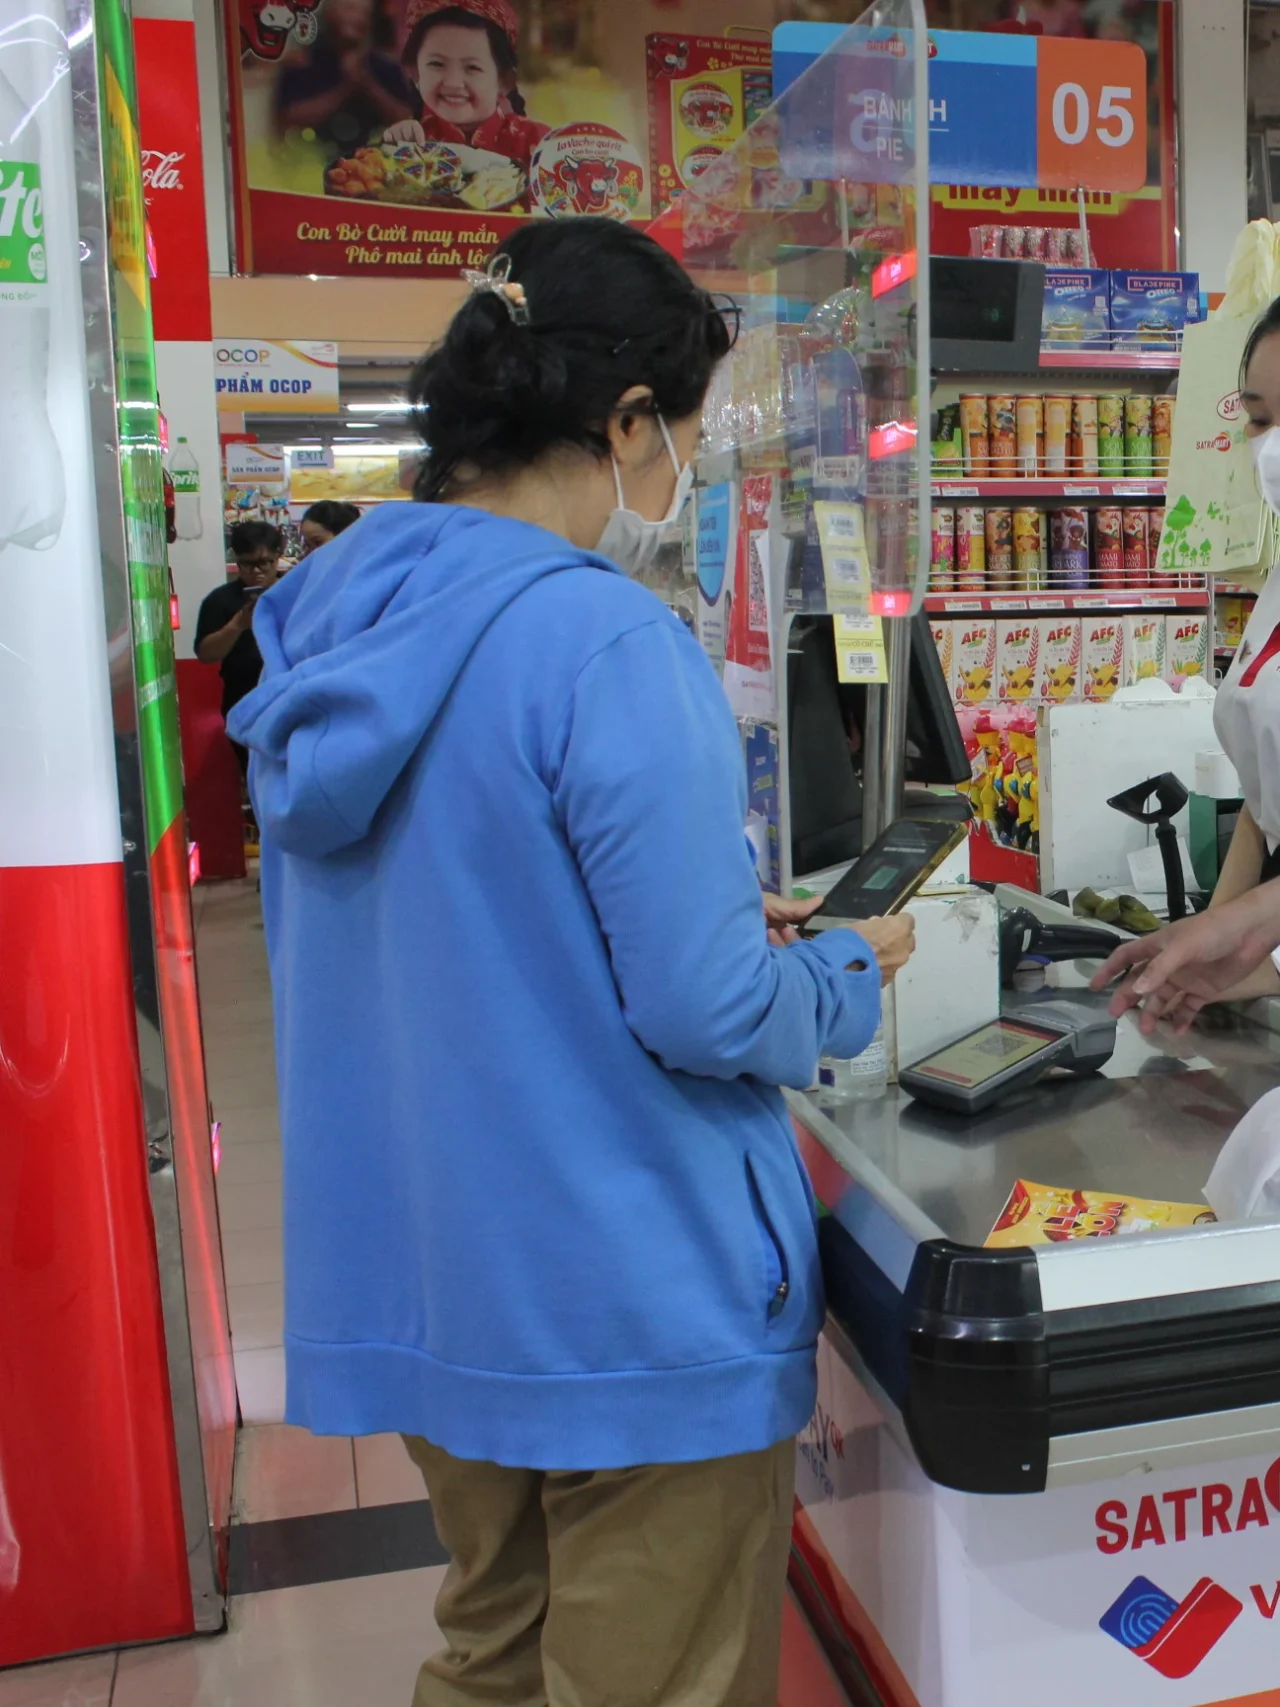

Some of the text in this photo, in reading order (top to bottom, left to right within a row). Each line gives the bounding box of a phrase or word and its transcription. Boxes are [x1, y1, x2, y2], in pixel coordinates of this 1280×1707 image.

[1052, 82, 1134, 147] 05
[876, 138, 904, 161] PIE
[297, 222, 331, 240] Con
[336, 222, 363, 241] Bò
[412, 229, 454, 248] may
[345, 245, 383, 264] Phô
[385, 248, 423, 265] mai
[216, 348, 271, 363] OCOP
[215, 372, 312, 393] PHẨM OCOP
[297, 450, 324, 461] EXIT
[961, 628, 988, 645] AFC
[1004, 628, 1030, 645] AFC
[1047, 625, 1072, 644] AFC
[1090, 626, 1115, 642] AFC
[1134, 622, 1157, 638] AFC
[1174, 622, 1199, 639] AFC
